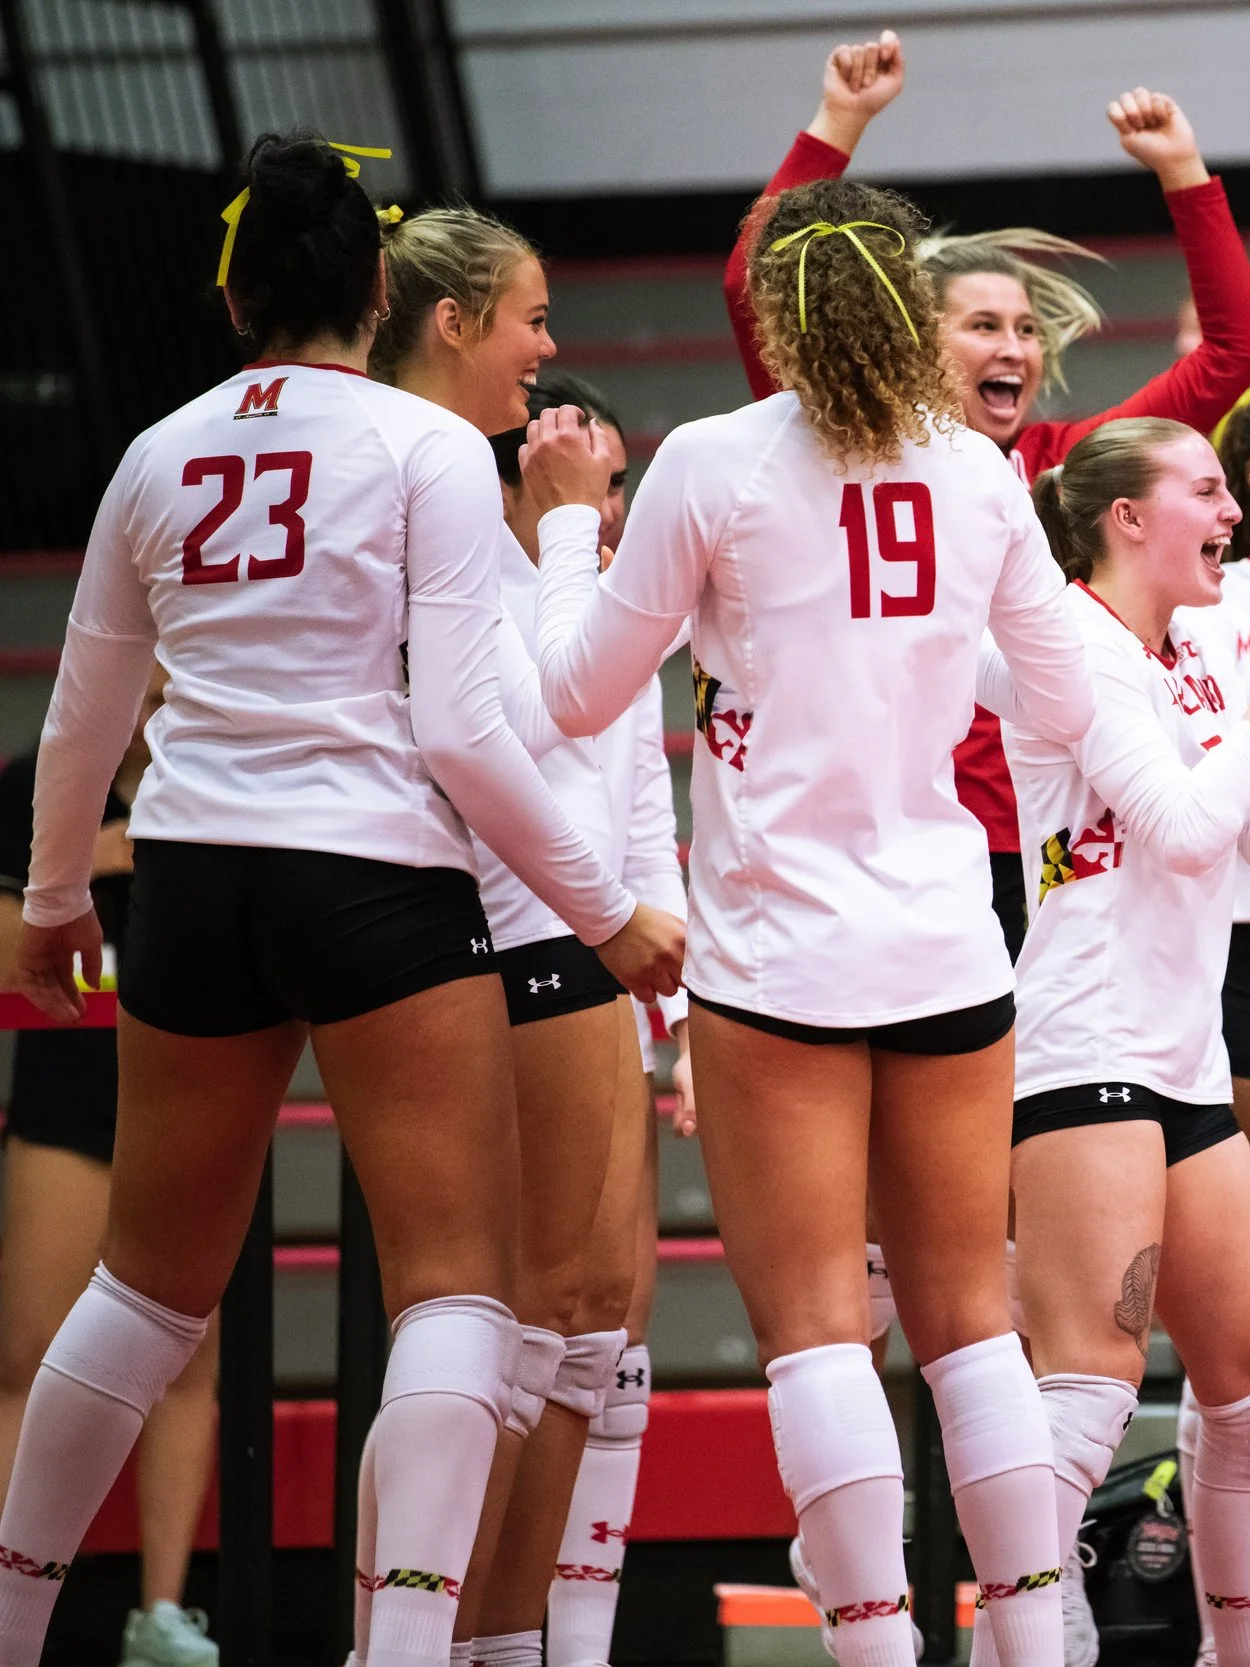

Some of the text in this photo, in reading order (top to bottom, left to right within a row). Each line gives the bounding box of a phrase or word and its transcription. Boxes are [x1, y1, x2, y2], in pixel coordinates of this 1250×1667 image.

[235, 377, 290, 414] M
[181, 450, 313, 586] 23
[839, 482, 936, 619] 19
